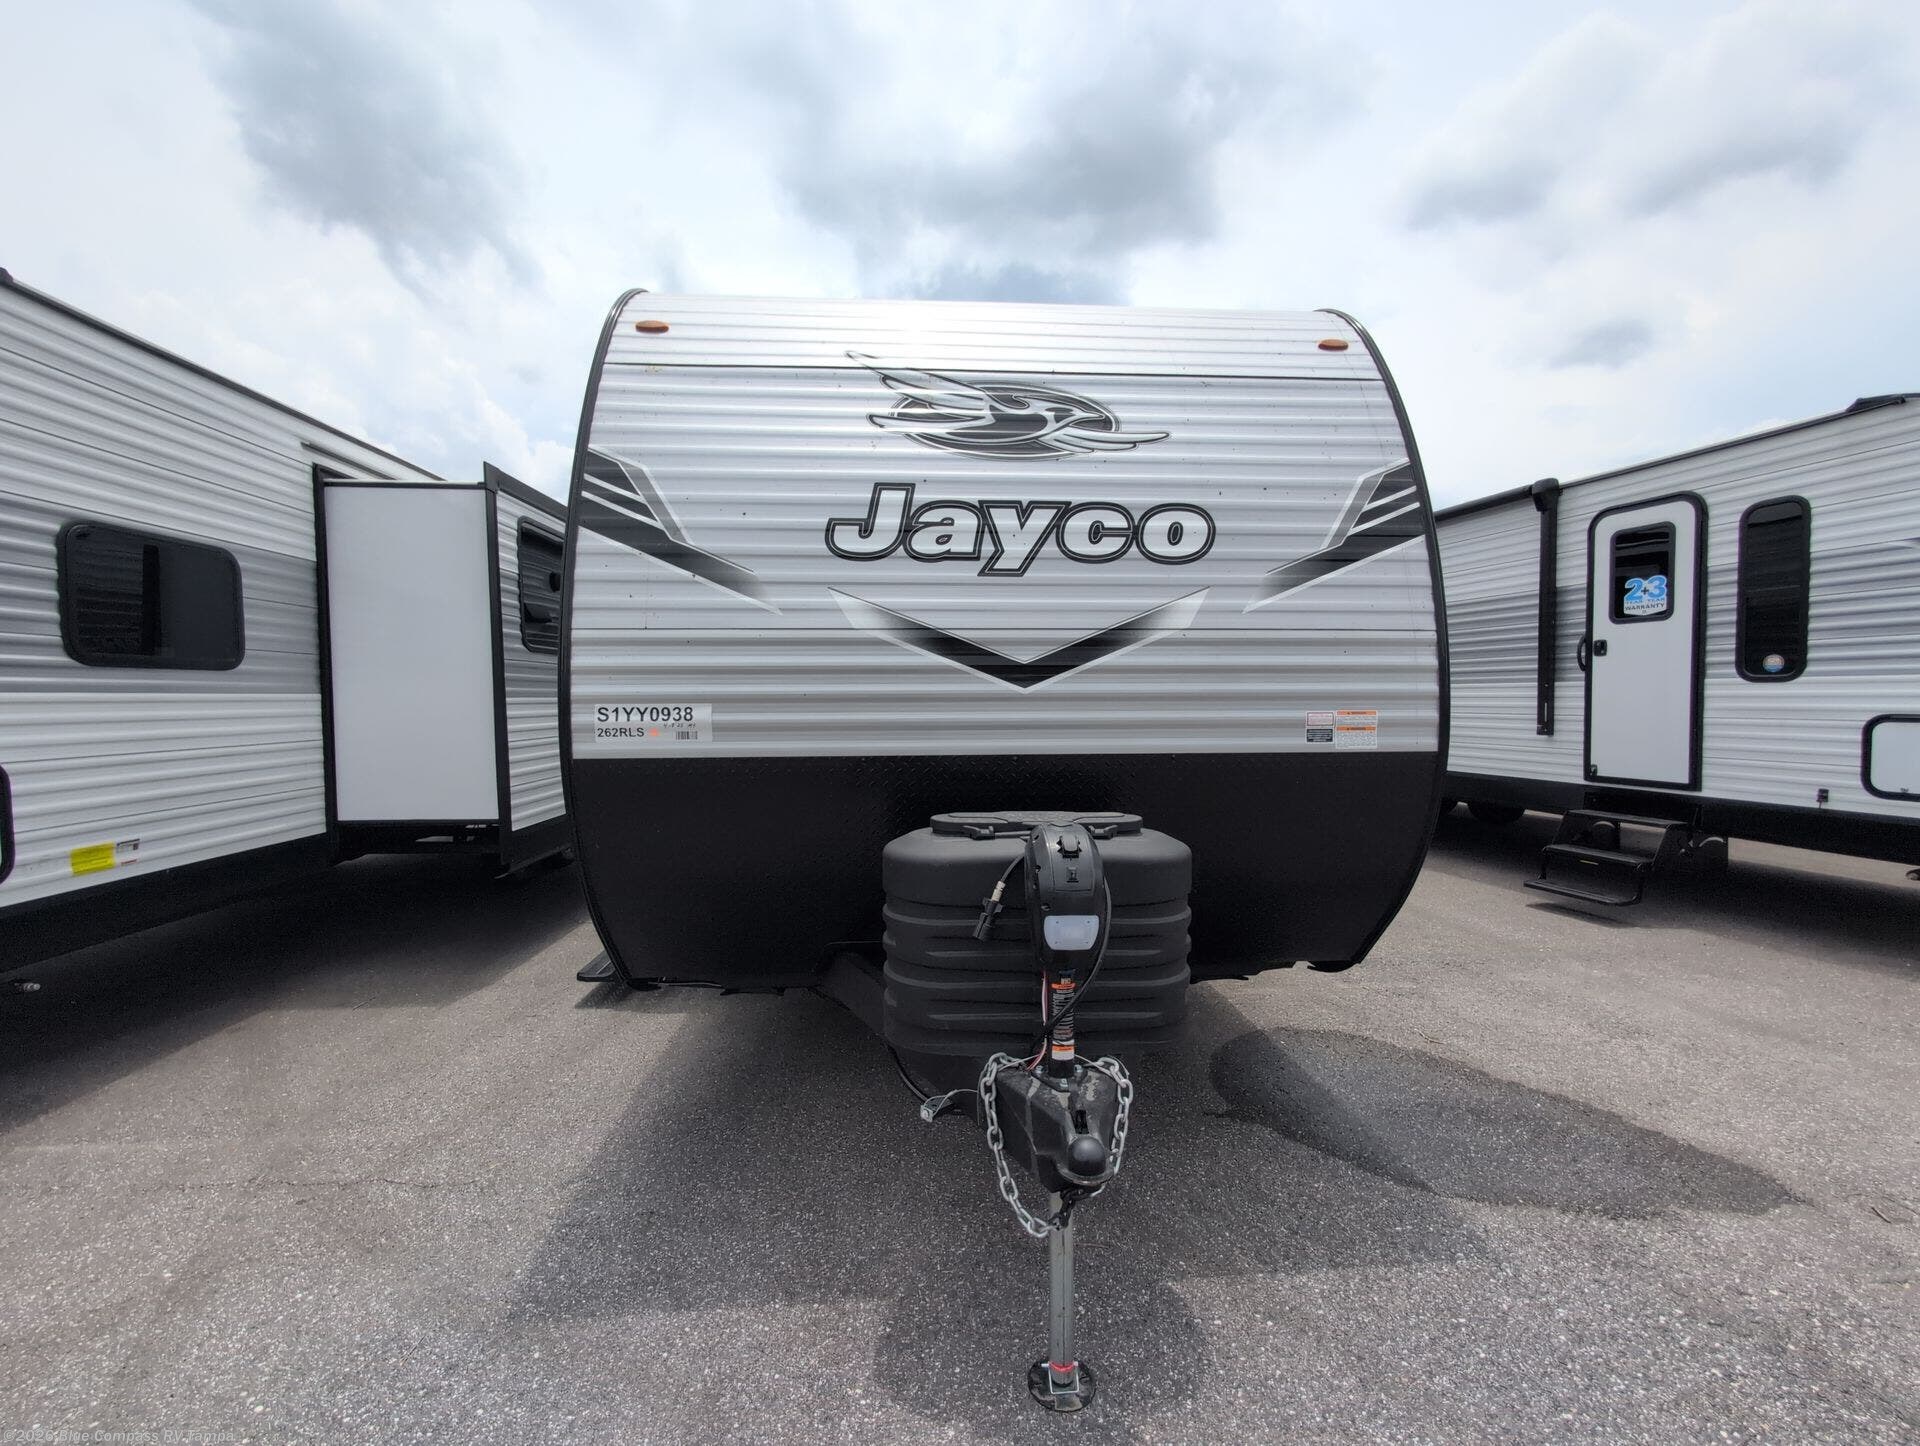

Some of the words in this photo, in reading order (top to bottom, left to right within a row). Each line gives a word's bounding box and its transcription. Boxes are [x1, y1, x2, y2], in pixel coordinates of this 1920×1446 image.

[824, 482, 1217, 577] Jayco
[1624, 602, 1665, 611] WARRANTY
[597, 706, 694, 722] S1YY0938
[597, 727, 645, 738] 262RLS
